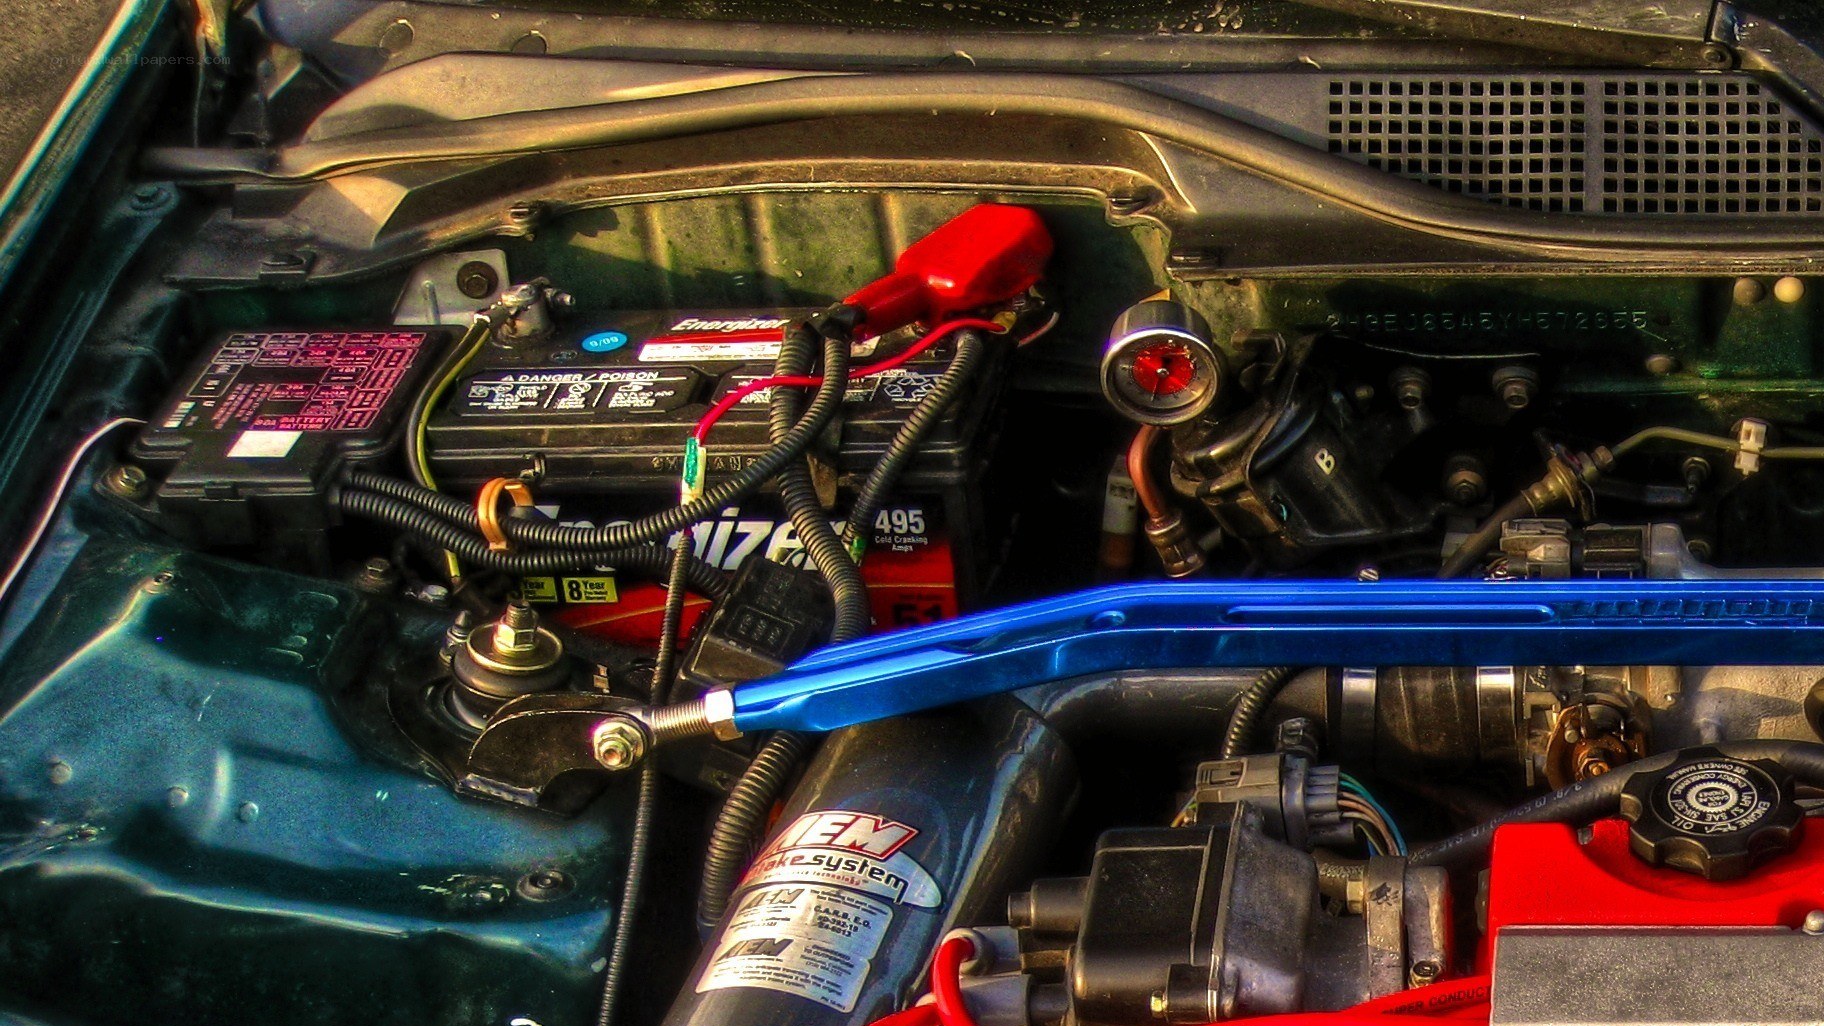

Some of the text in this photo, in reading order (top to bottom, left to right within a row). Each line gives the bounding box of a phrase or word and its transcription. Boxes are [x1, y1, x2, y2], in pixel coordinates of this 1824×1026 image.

[671, 318, 792, 332] Energizer
[518, 374, 583, 382] DANGER
[599, 372, 659, 380] POISON
[1314, 447, 1335, 475] B
[874, 509, 926, 534] 495
[567, 580, 582, 601] 8
[582, 581, 605, 590] Year
[1671, 800, 1771, 830] ENGINE OIL
[1705, 812, 1728, 822] SAE
[811, 854, 909, 905] system
